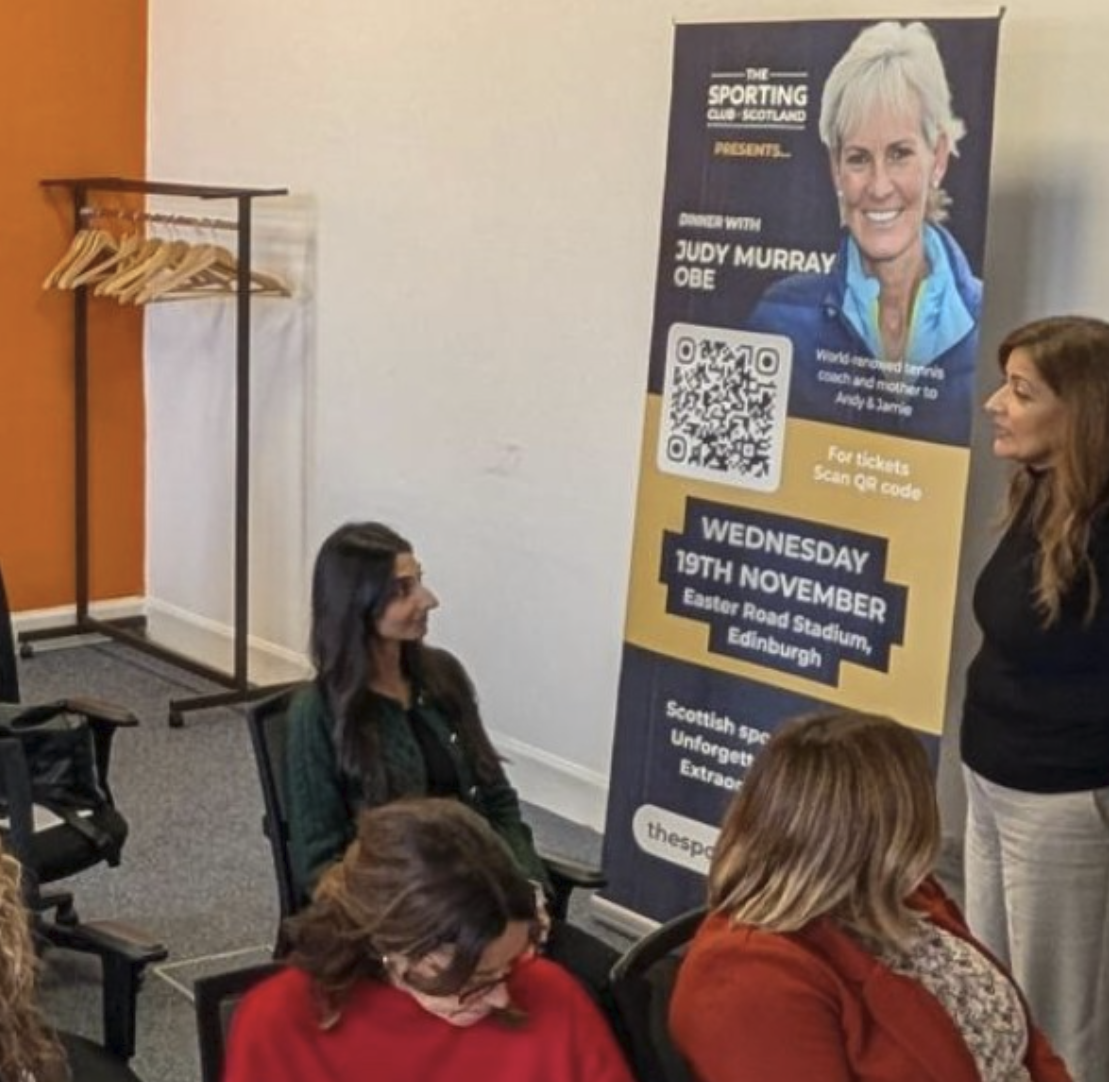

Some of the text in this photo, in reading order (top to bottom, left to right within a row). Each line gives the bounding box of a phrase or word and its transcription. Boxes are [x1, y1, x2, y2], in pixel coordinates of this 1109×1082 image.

[746, 67, 769, 80] THE
[708, 84, 808, 106] SPORTING
[707, 108, 806, 122] CLUB SCOTLAND
[679, 212, 761, 232] DINNER WITH
[675, 240, 836, 274] JUDY MURRAY
[673, 266, 716, 290] OBE
[817, 369, 938, 400] coach and mother to
[905, 363, 945, 380] tennis
[835, 391, 913, 416] Andy & Jamie
[828, 445, 910, 476] For tickets
[813, 465, 922, 501] Scan QR code
[701, 516, 870, 575] WEDNESDAY
[676, 550, 888, 624] 19TH NOVEMBER
[683, 587, 872, 655] Easter Road Stadium,
[727, 626, 822, 668] Edinburgh
[665, 700, 735, 735] Scottish
